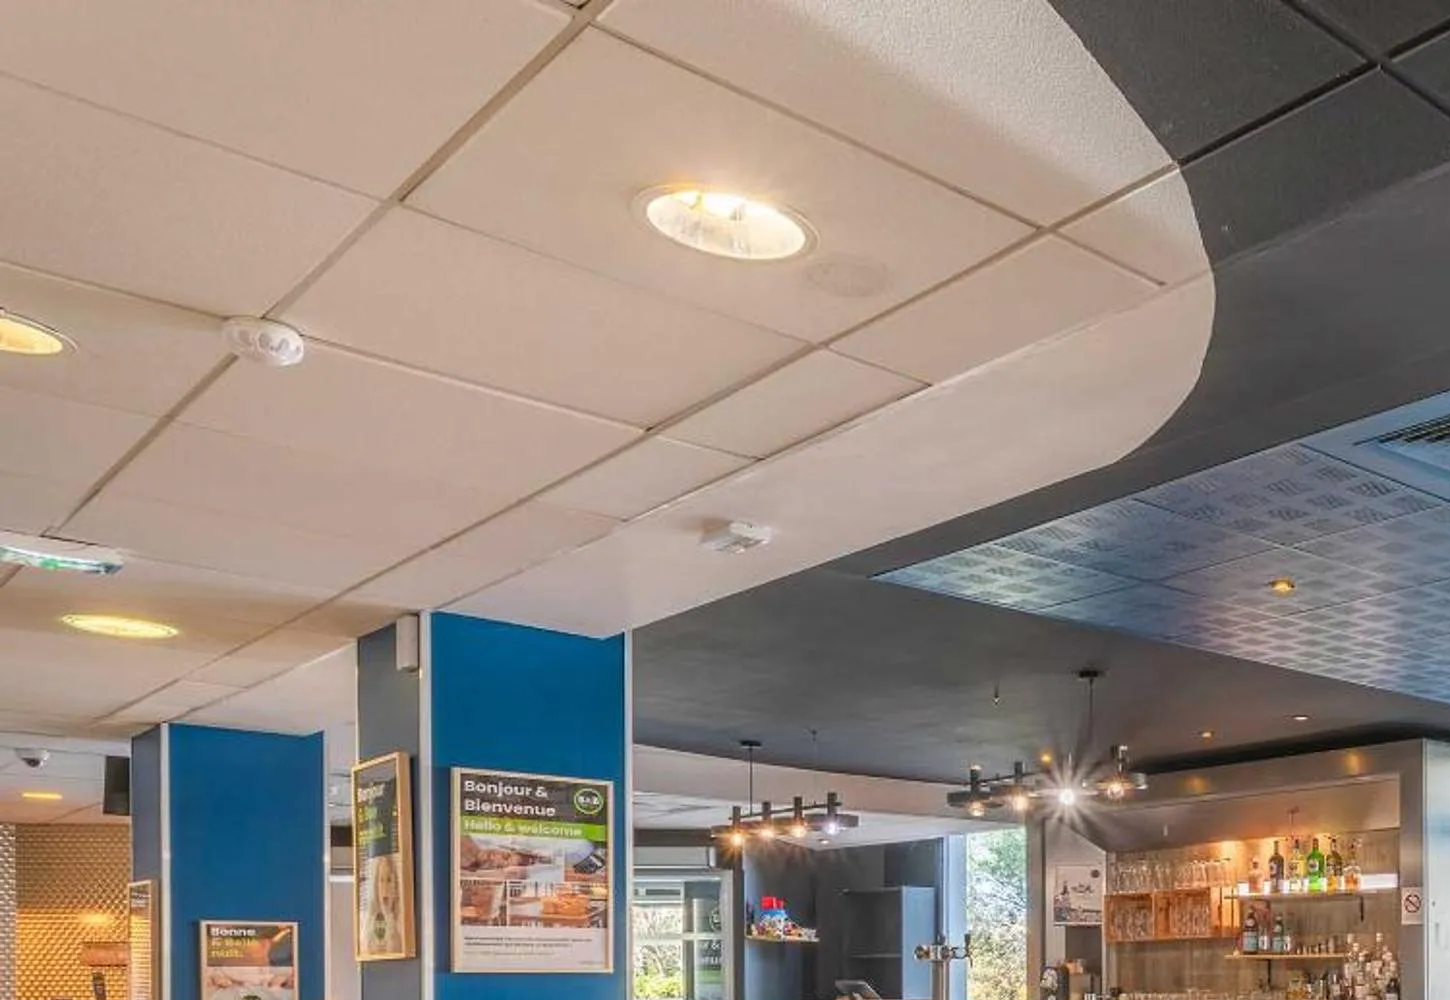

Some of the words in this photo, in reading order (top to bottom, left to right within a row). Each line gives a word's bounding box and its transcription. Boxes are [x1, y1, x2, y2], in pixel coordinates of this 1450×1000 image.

[464, 780, 532, 797] Bonjour
[535, 786, 548, 798] &
[464, 798, 556, 817] Bienvenue
[464, 819, 502, 831] Hello
[518, 824, 583, 837] welcome
[211, 927, 256, 937] Bonne
